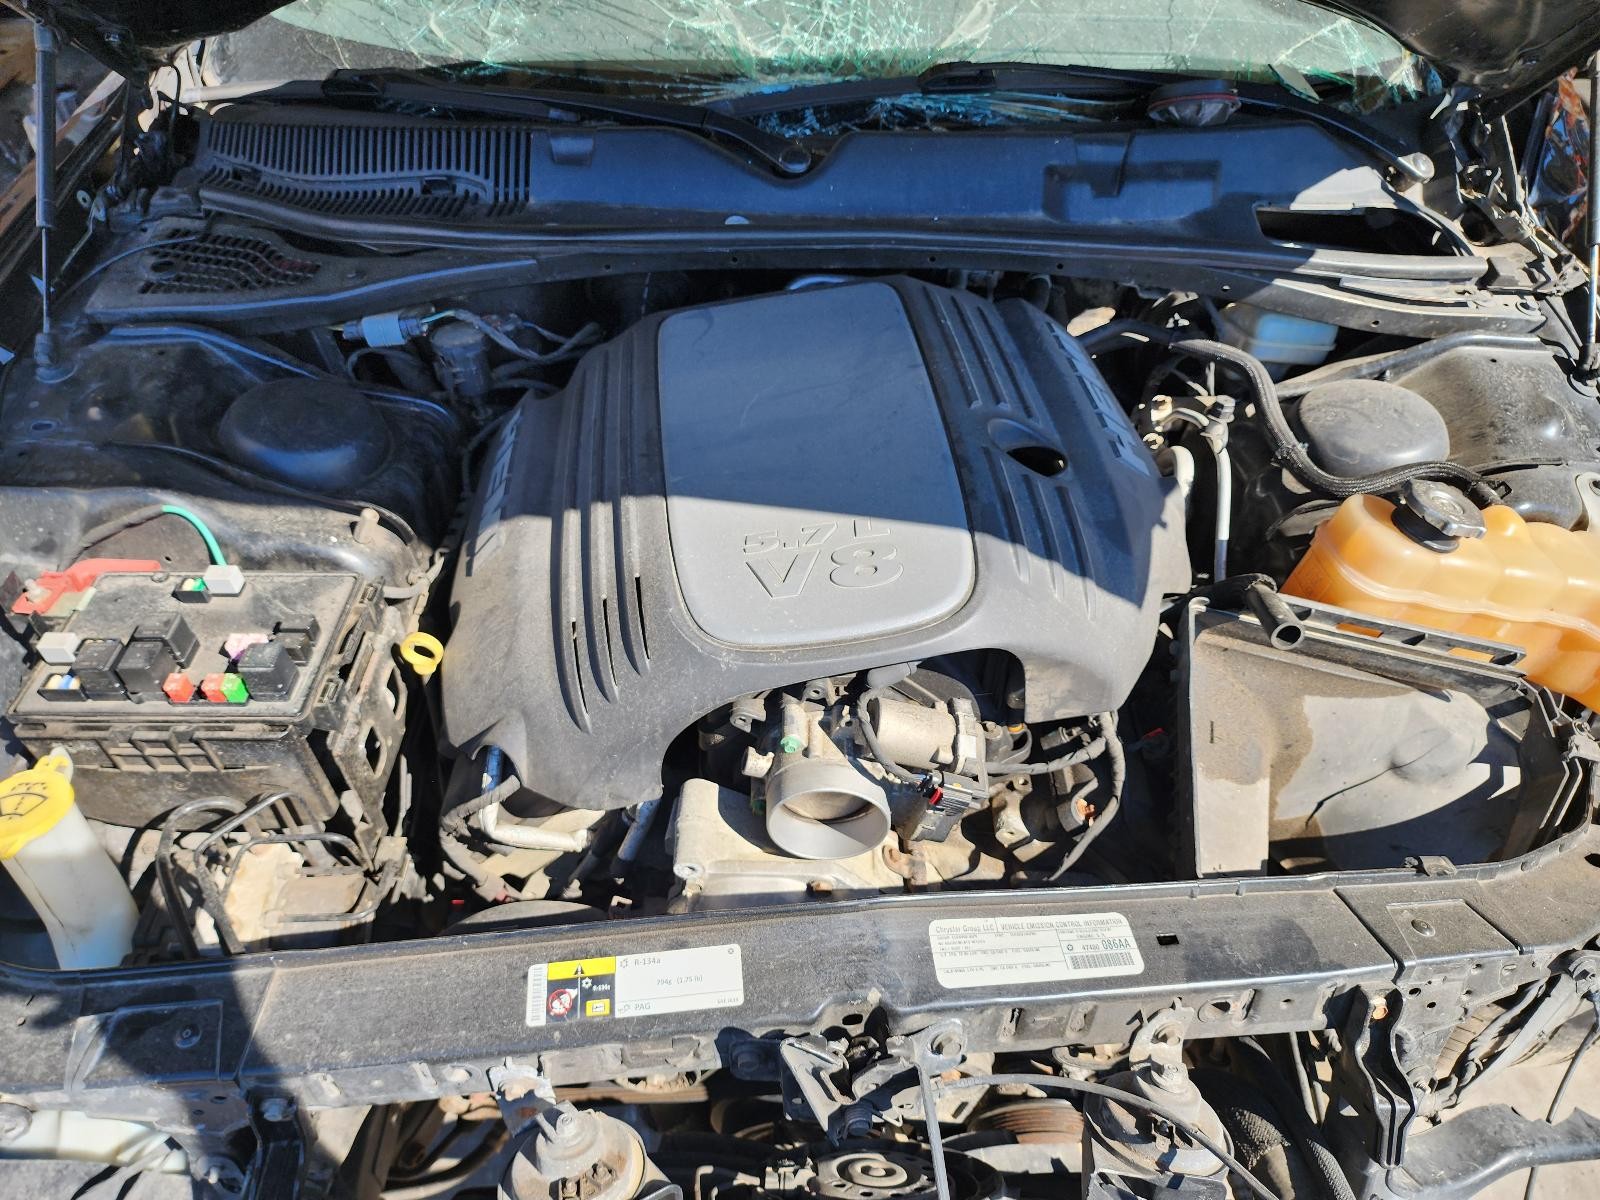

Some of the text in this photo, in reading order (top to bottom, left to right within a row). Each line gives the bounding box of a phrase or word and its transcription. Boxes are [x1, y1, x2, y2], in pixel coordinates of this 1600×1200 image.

[745, 541, 904, 600] V8
[982, 923, 995, 932] LLC
[1001, 918, 1123, 931] VEHICLE EMISSION CONTROL INFORMATION
[634, 957, 661, 968] R-134a
[634, 1002, 651, 1011] PAG
